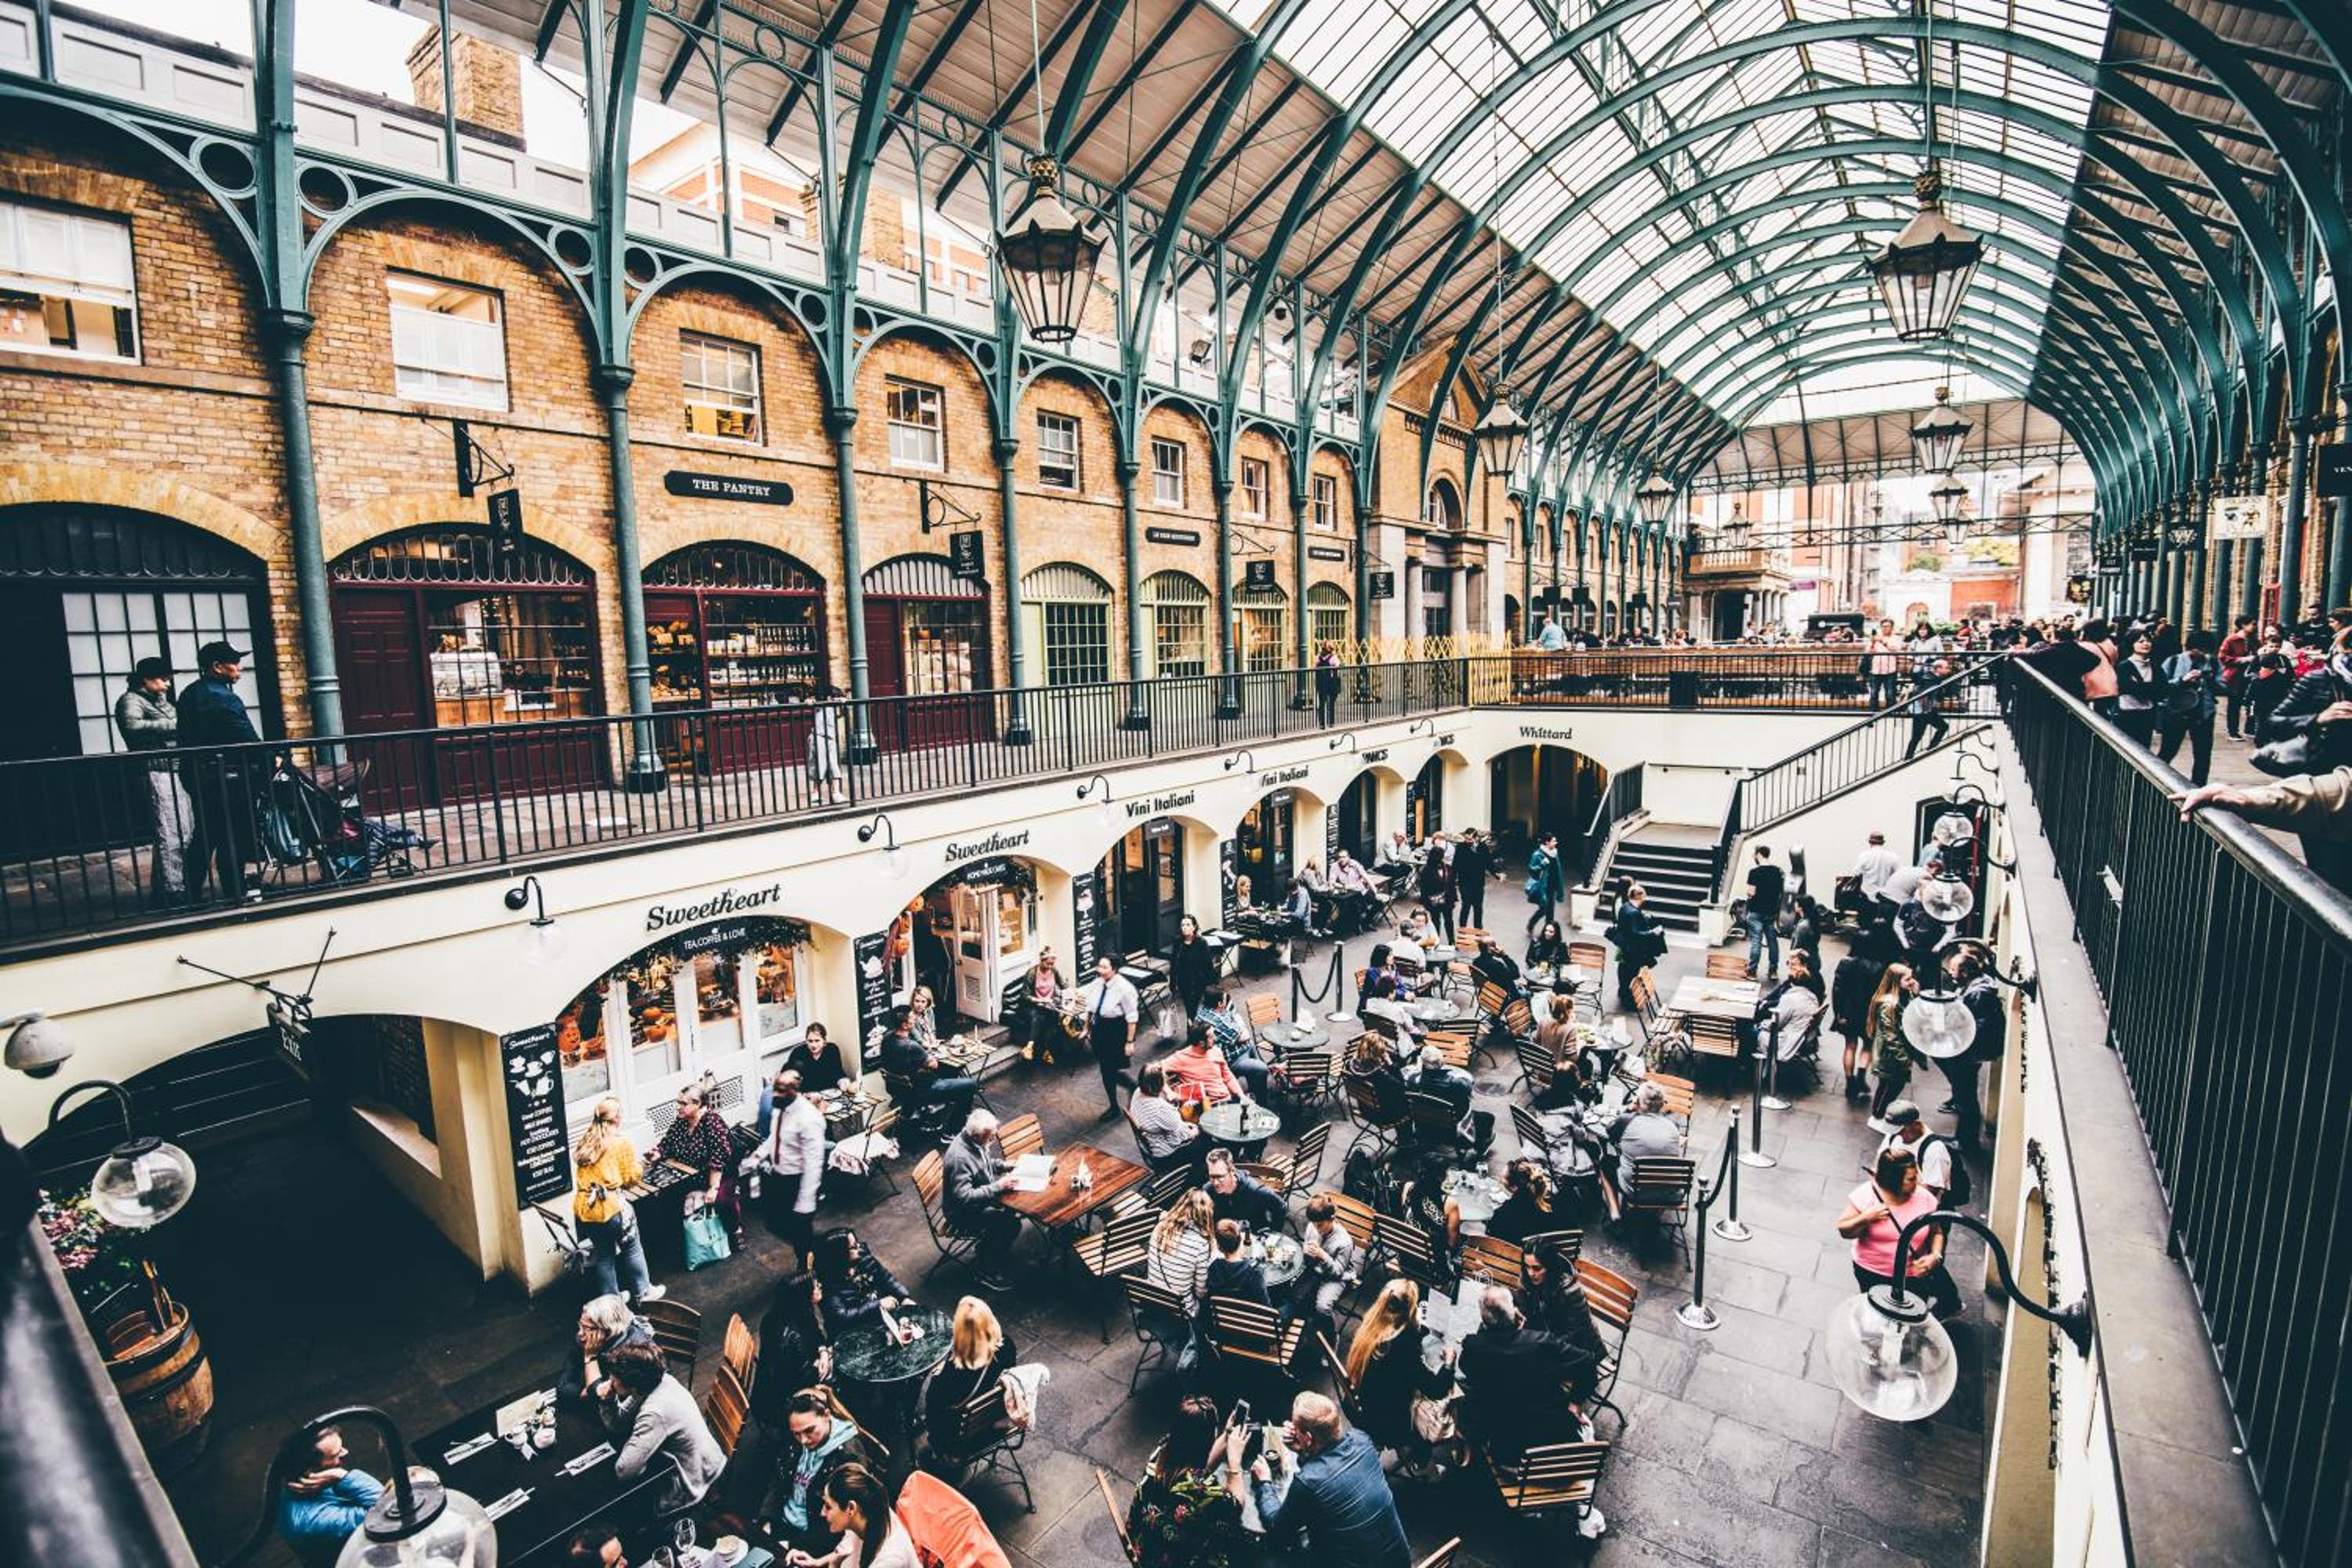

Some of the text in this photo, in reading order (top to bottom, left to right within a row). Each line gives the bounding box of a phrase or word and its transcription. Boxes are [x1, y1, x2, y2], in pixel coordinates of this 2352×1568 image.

[692, 479, 771, 496] THE PANTRY
[1519, 727, 1572, 739] Whittard
[1126, 790, 1195, 818] Vini Italiani
[946, 829, 1029, 862] Sweetheart
[647, 884, 780, 931] Sweetheart
[728, 927, 746, 939] LOVE
[509, 1033, 550, 1050] Sweetheart
